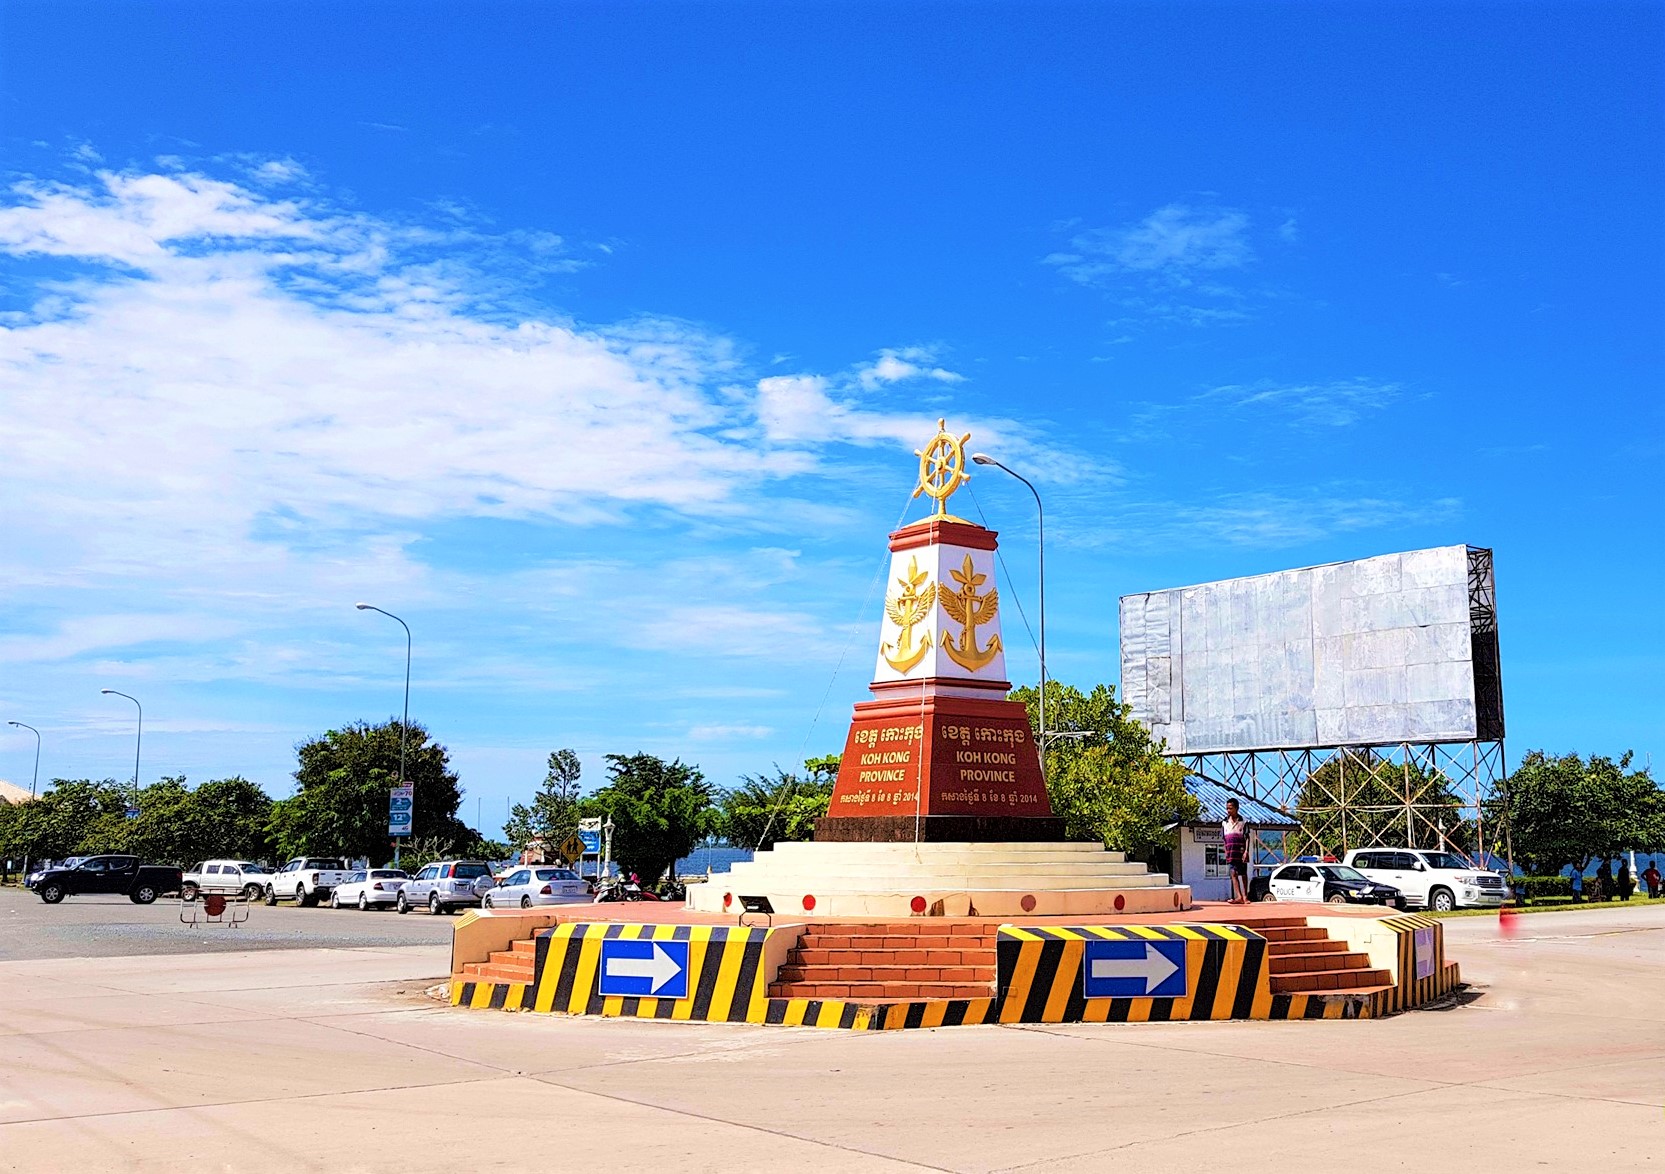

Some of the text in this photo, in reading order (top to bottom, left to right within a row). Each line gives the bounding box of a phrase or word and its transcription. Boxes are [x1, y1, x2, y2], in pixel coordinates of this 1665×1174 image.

[861, 751, 911, 765] KOH KONG
[956, 750, 1016, 765] KOH KONG
[859, 770, 905, 782] PROVINCE
[960, 769, 1016, 783] PROVINCE
[902, 791, 919, 802] 2014
[1020, 794, 1038, 804] 2014
[1276, 887, 1295, 896] POLICE
